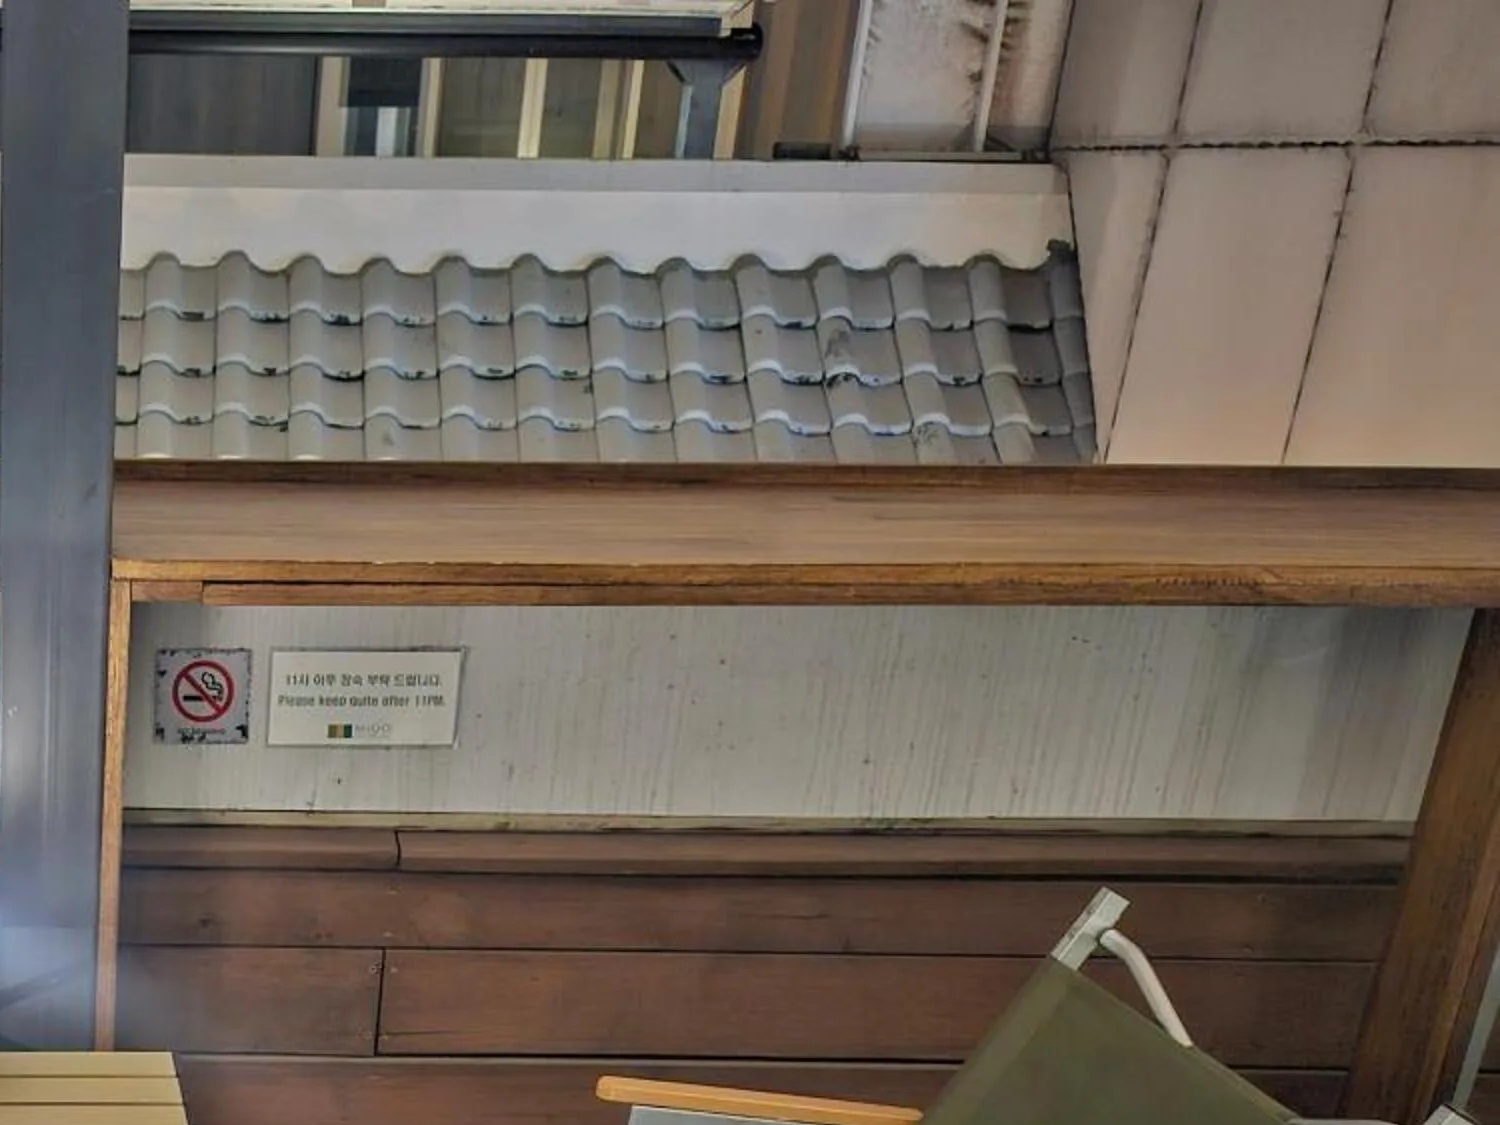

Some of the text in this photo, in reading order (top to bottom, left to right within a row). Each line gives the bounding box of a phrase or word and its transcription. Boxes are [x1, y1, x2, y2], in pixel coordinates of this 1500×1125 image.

[367, 673, 390, 687] 부탁
[278, 694, 315, 707] Please
[319, 694, 347, 707] keep
[381, 694, 410, 707] after
